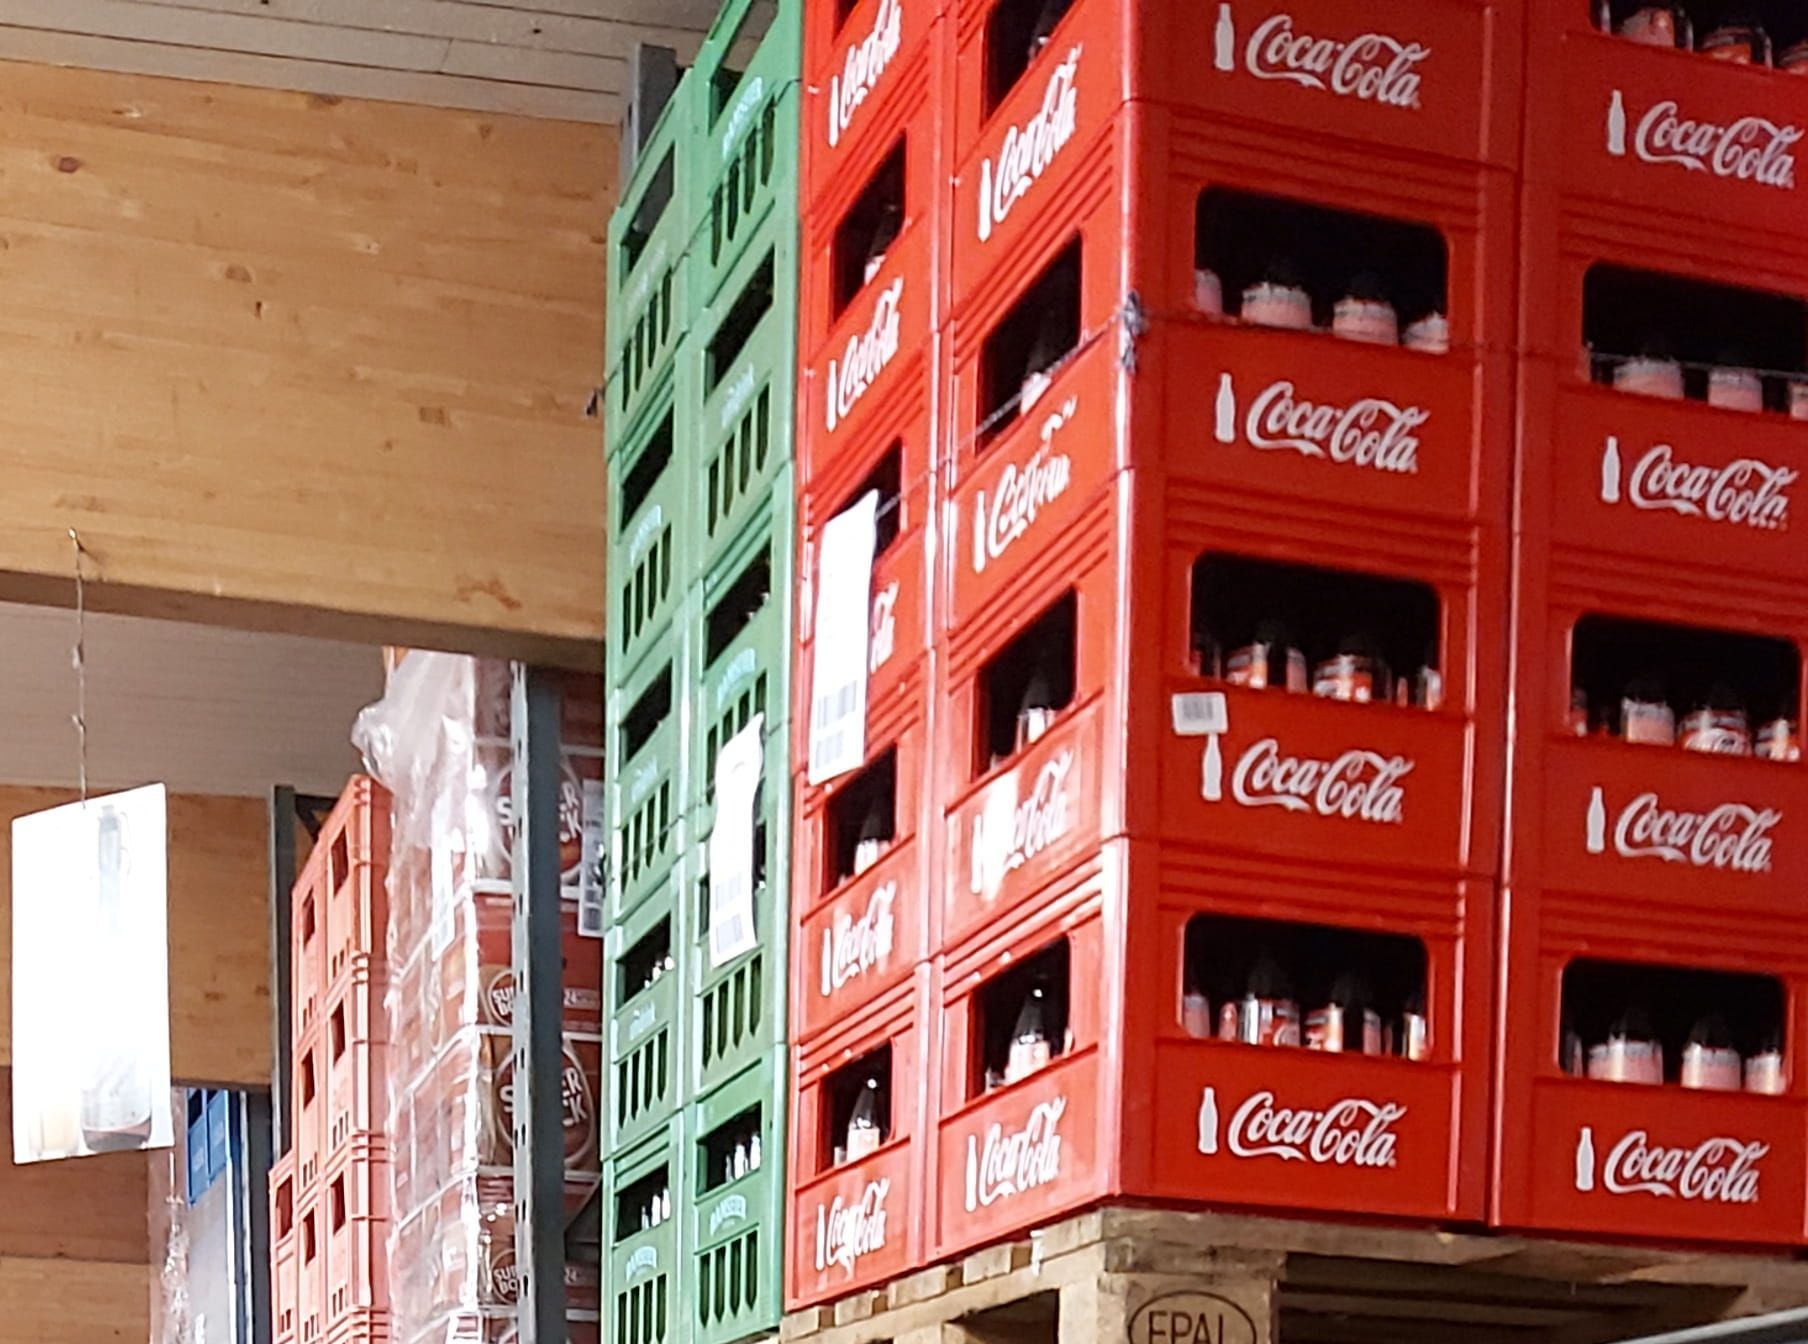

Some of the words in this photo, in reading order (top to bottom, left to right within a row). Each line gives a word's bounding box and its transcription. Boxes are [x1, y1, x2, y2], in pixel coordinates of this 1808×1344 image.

[1246, 15, 1430, 108] Coca-Cola
[1635, 101, 1805, 188] Coca-Cola
[1246, 381, 1430, 473] Coca-Cola
[1628, 445, 1799, 531] Coca-Cola
[1233, 738, 1415, 824] Coca-Cola
[1614, 793, 1783, 873] Coca-Cola
[979, 1096, 1067, 1207] Coca-Cola
[1228, 1090, 1408, 1169] Coca-Cola
[1604, 1131, 1771, 1203] Coca-Cola
